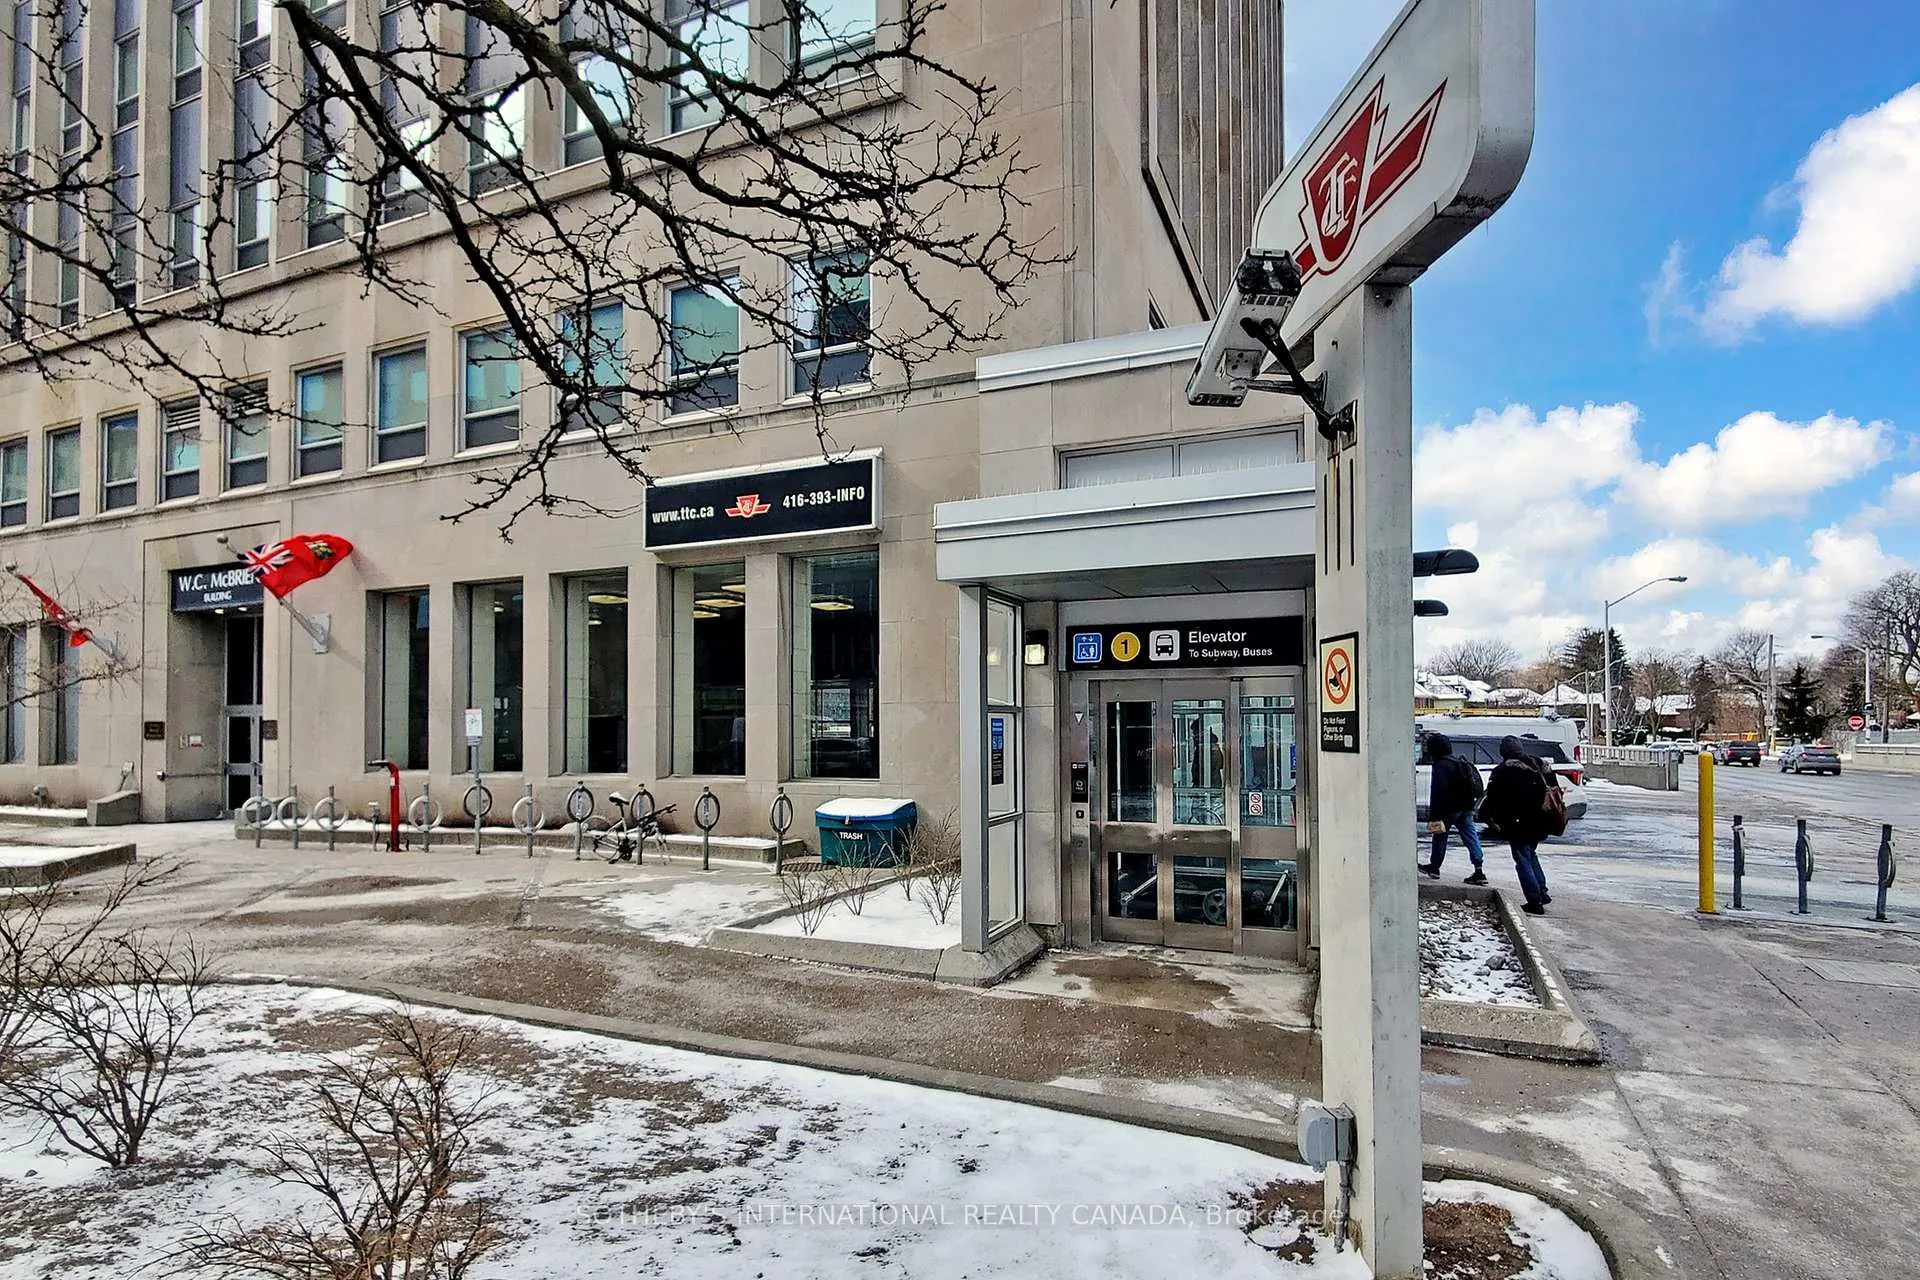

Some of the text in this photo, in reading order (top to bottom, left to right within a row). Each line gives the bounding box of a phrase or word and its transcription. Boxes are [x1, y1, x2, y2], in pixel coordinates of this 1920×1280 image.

[782, 486, 865, 509] 416-393-INFO
[652, 504, 715, 524] www.ttc.ca
[179, 573, 207, 592] W.C.
[1188, 630, 1247, 643] Elevator
[1121, 639, 1129, 655] 1
[1188, 647, 1273, 659] To Subway, Buses
[839, 831, 863, 840] TRASH
